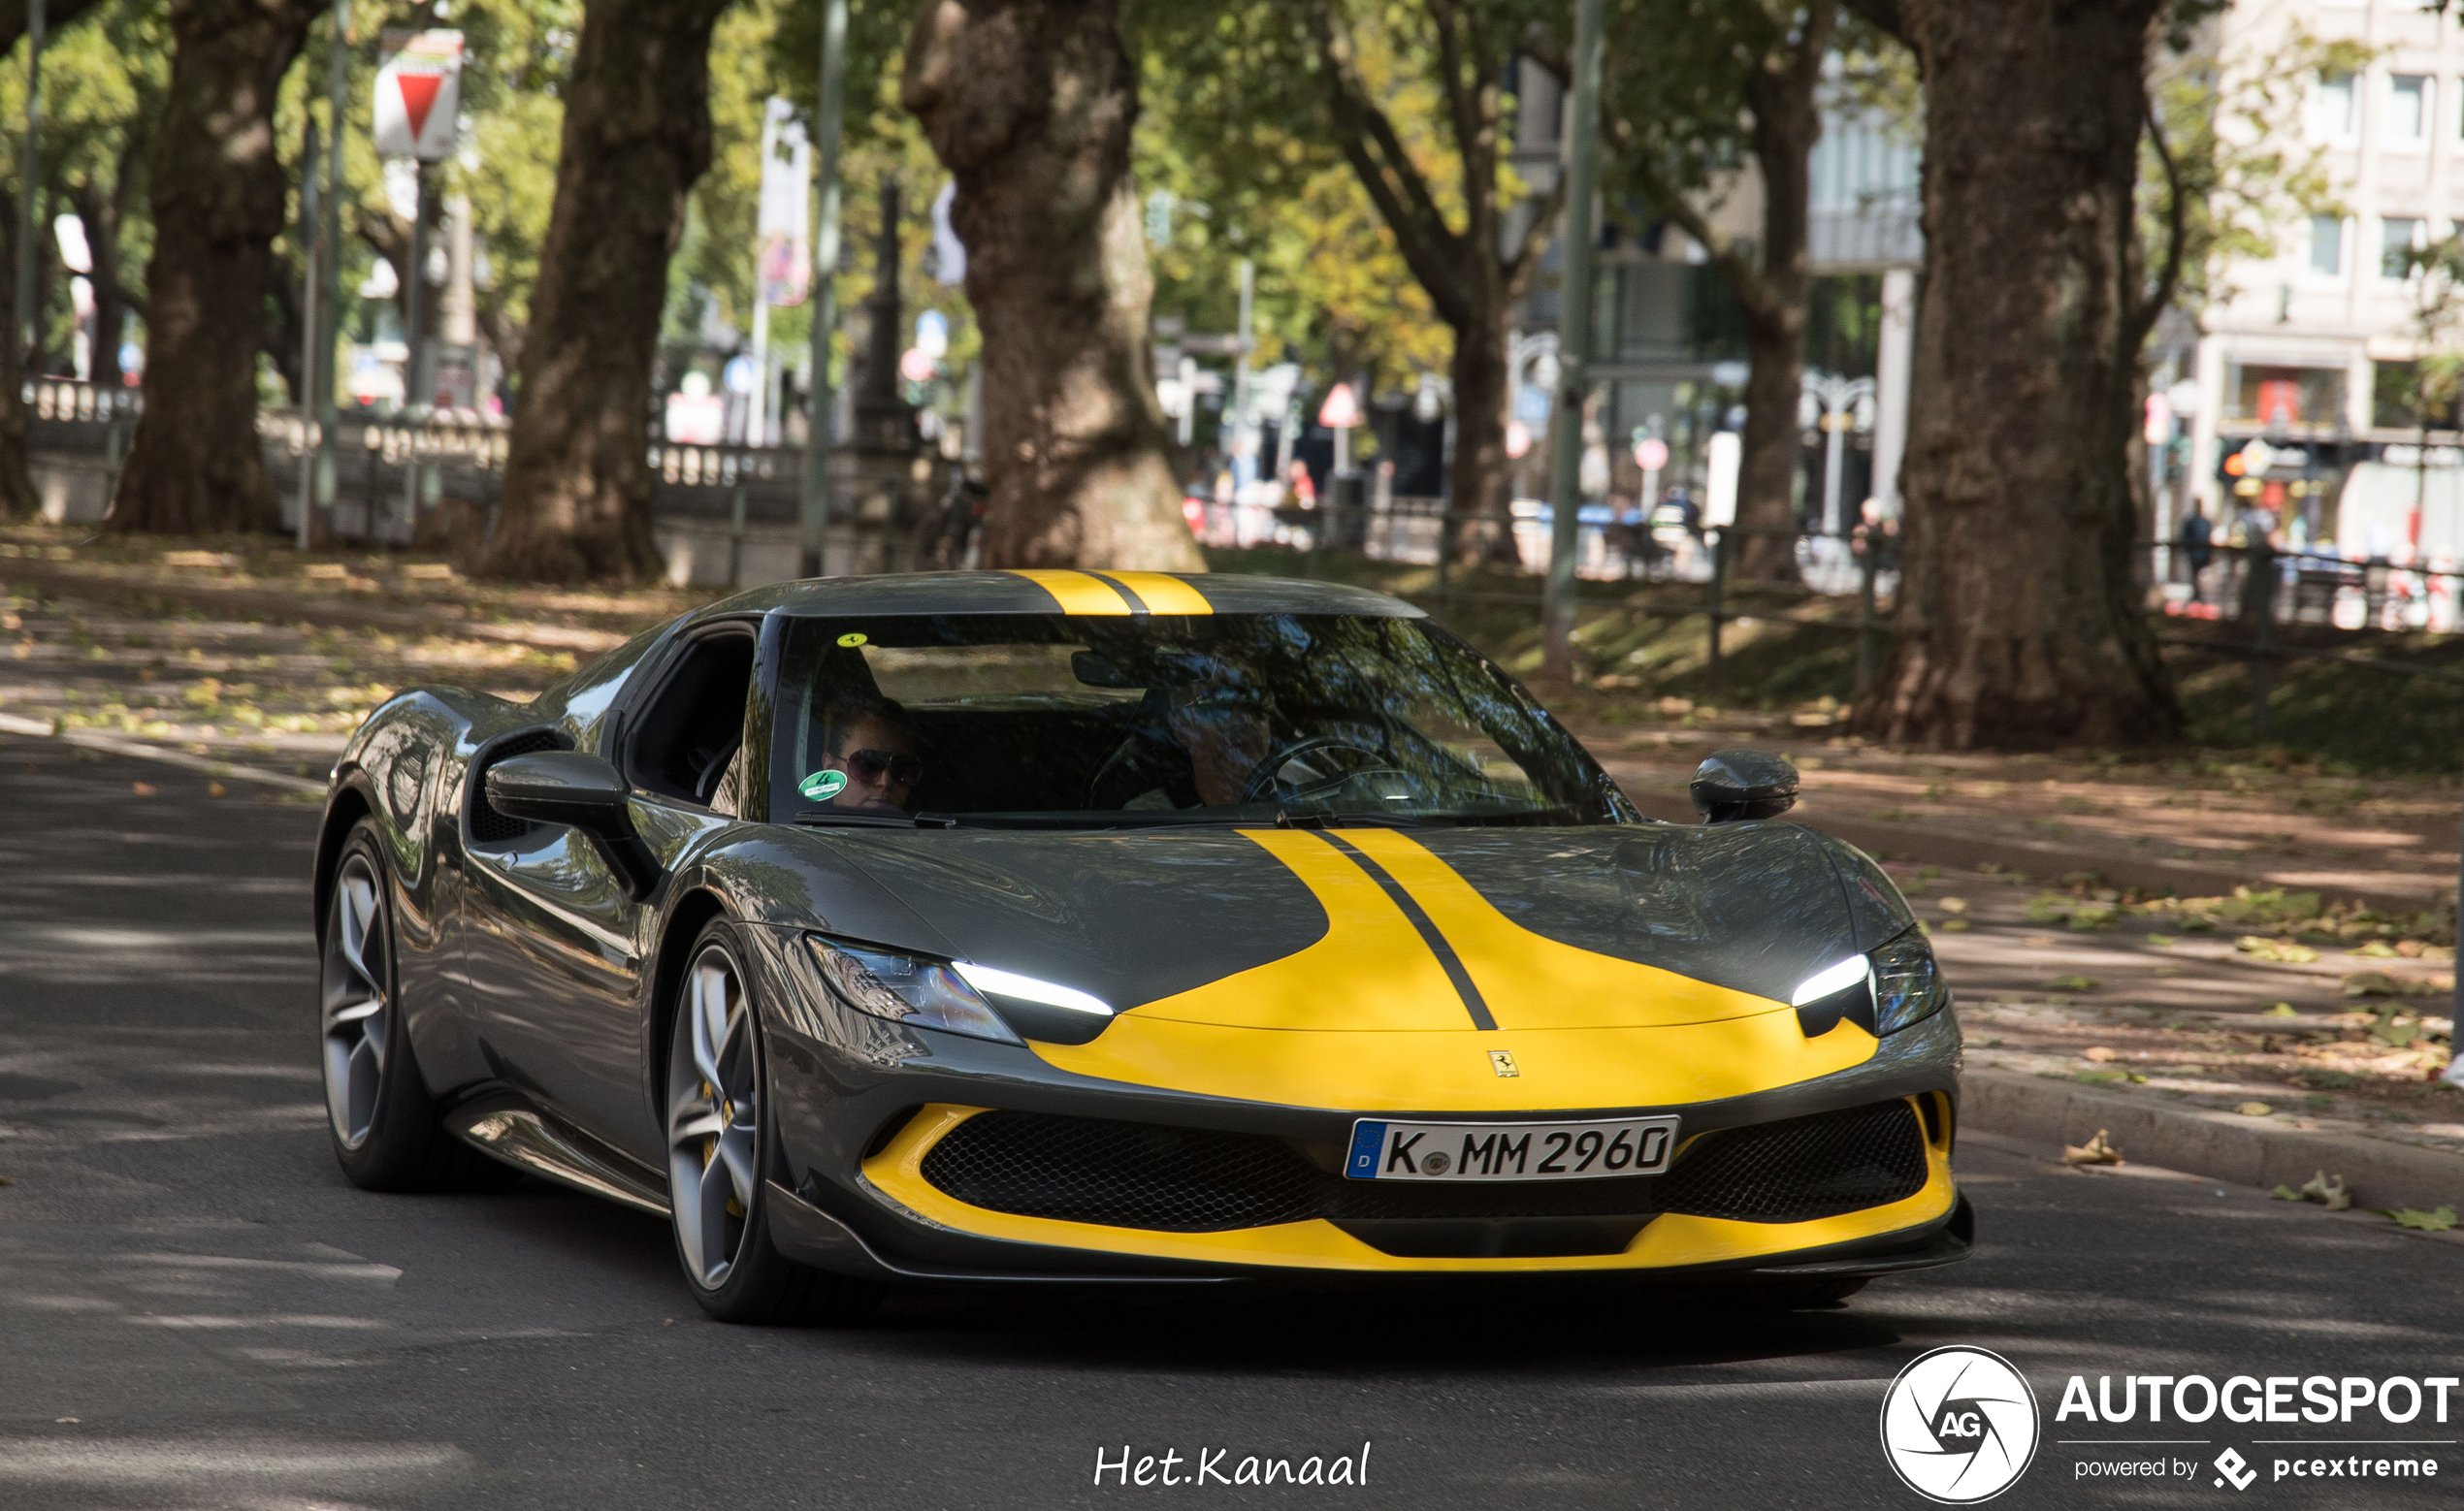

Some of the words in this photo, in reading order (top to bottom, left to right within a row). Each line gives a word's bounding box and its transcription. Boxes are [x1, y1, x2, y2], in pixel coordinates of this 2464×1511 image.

[1358, 1155, 1370, 1168] D
[1386, 1130, 1427, 1173] K
[1457, 1131, 1532, 1175] MM
[1538, 1126, 1670, 1173] 2960
